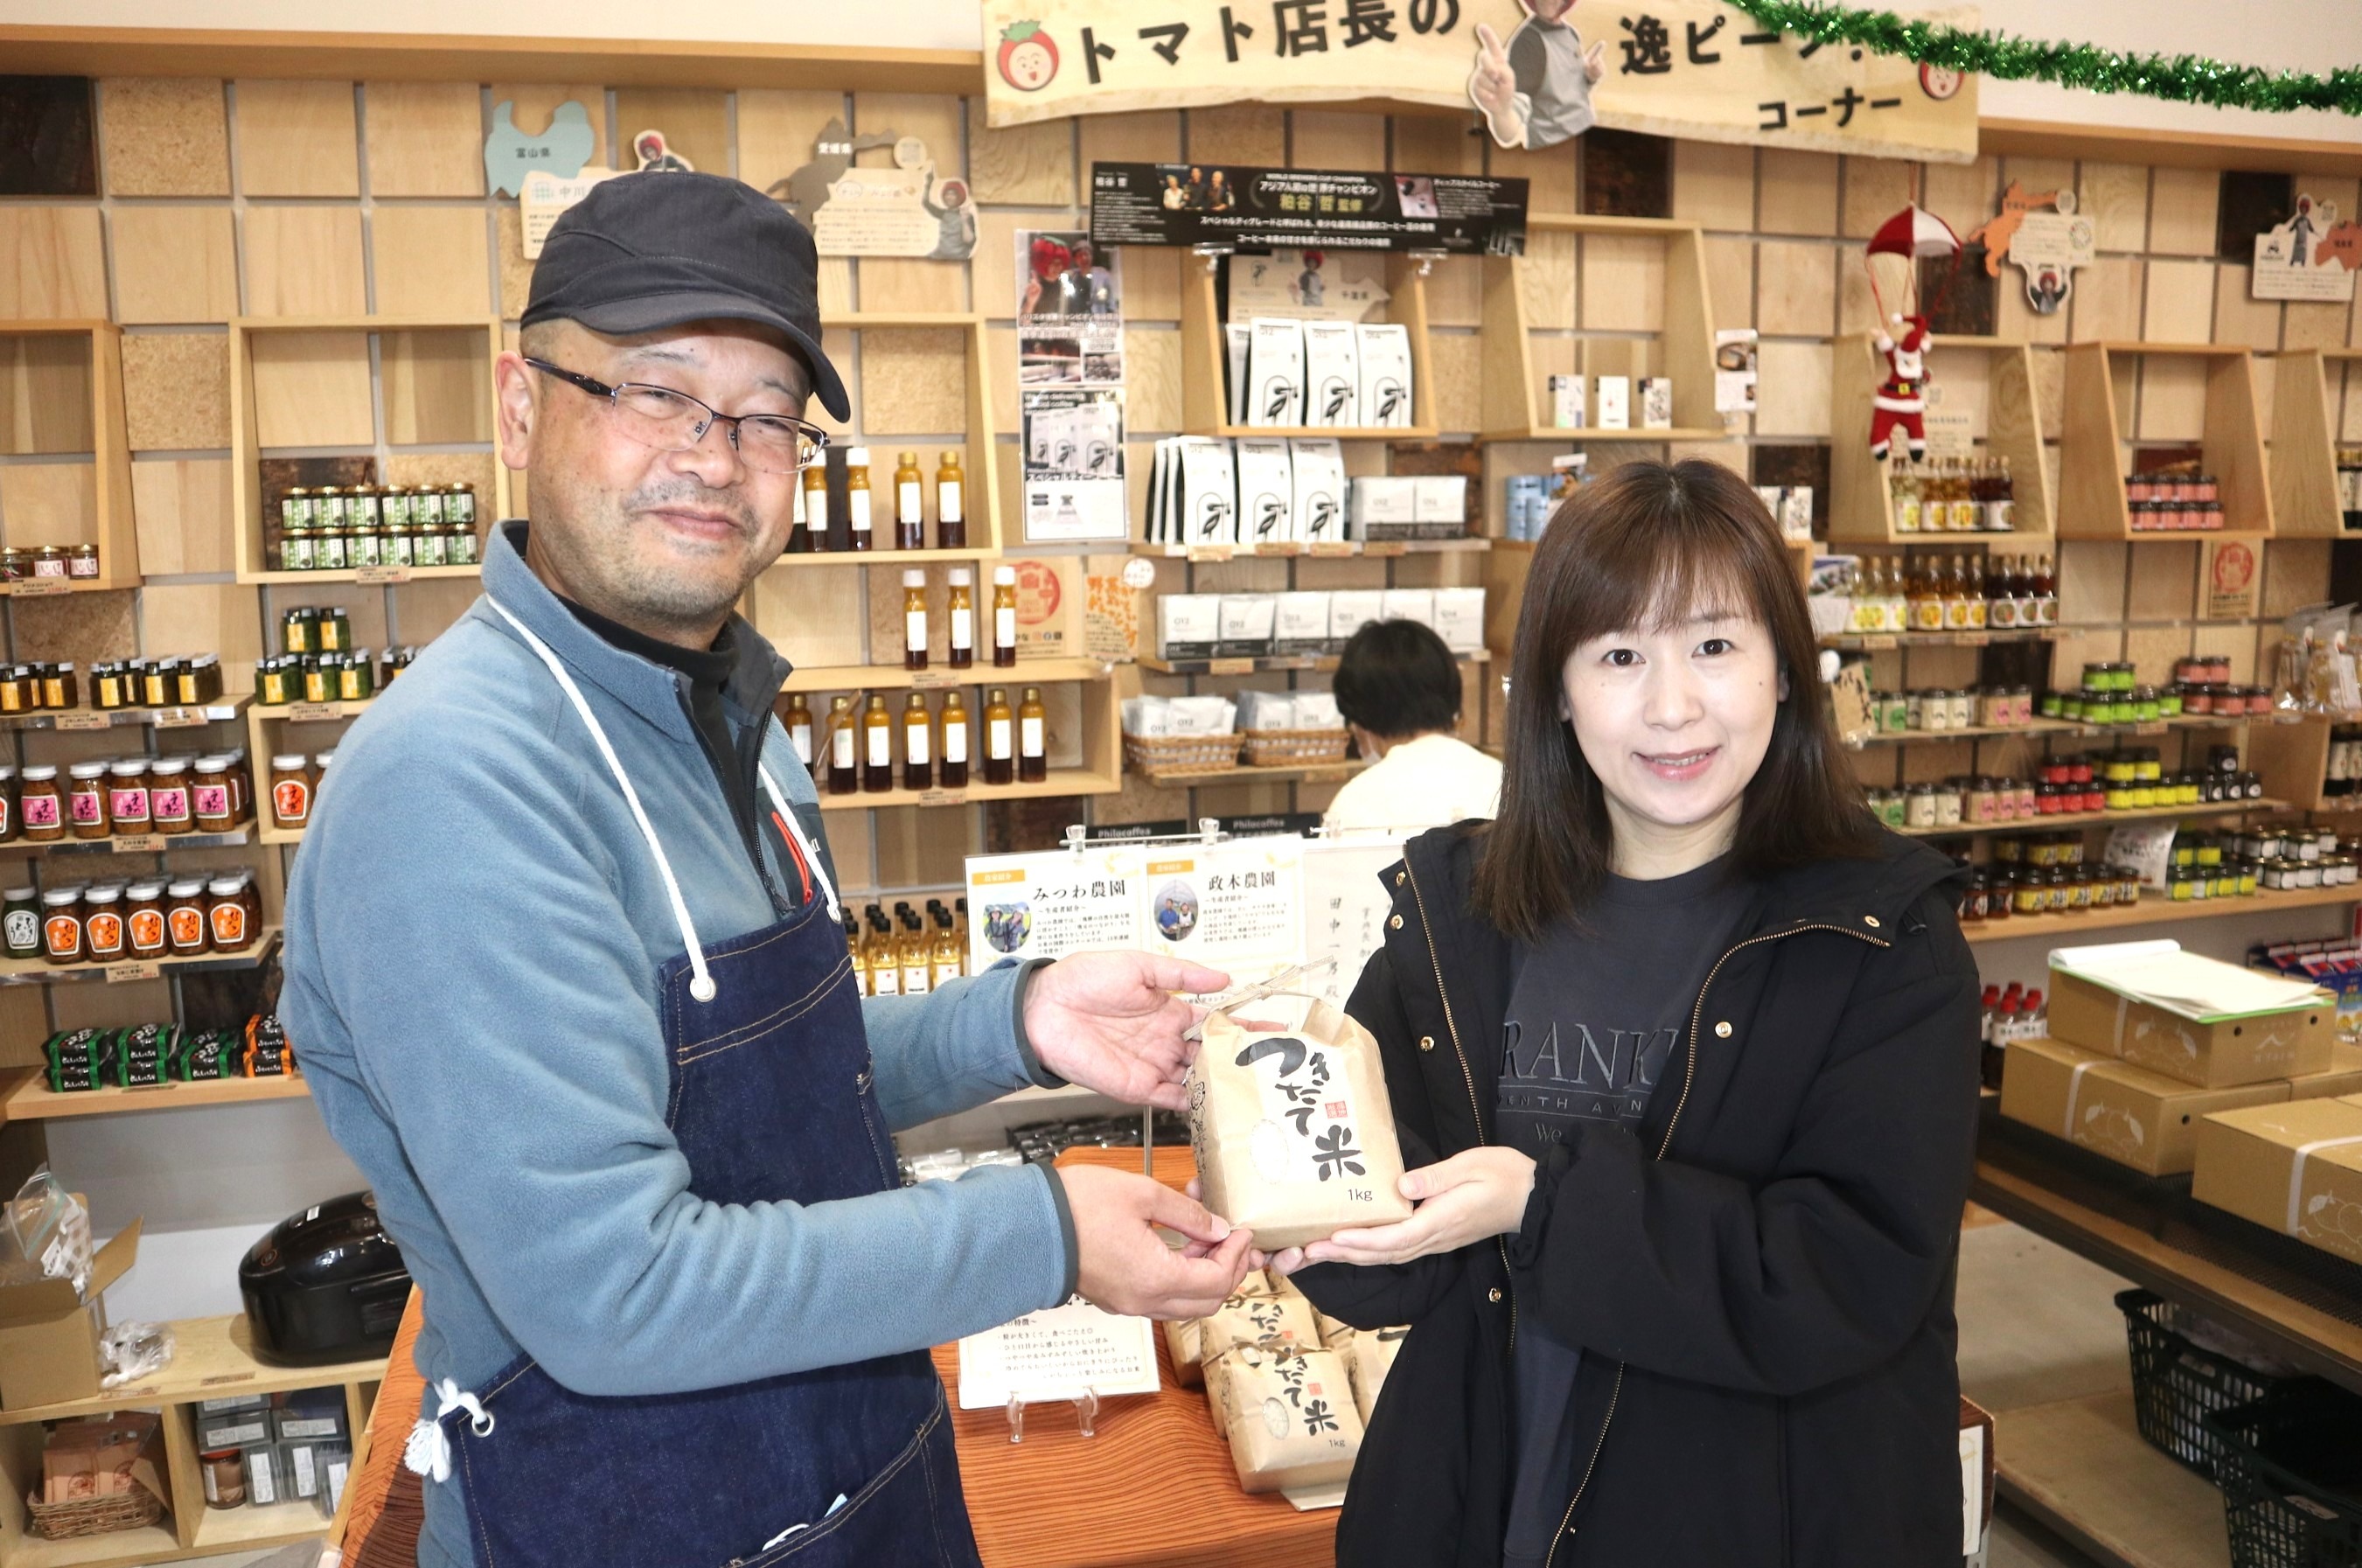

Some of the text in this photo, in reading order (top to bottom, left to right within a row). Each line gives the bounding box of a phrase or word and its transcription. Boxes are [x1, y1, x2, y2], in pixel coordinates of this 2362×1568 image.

[1081, 0, 1460, 85] トマト店長の
[1758, 87, 1902, 130] コーナー
[516, 147, 551, 158] 富山県
[1033, 879, 1126, 902] みつわ農園
[1208, 870, 1276, 892] 政木農園
[1348, 1188, 1373, 1202] 1kg
[1328, 1439, 1346, 1449] 1kg
